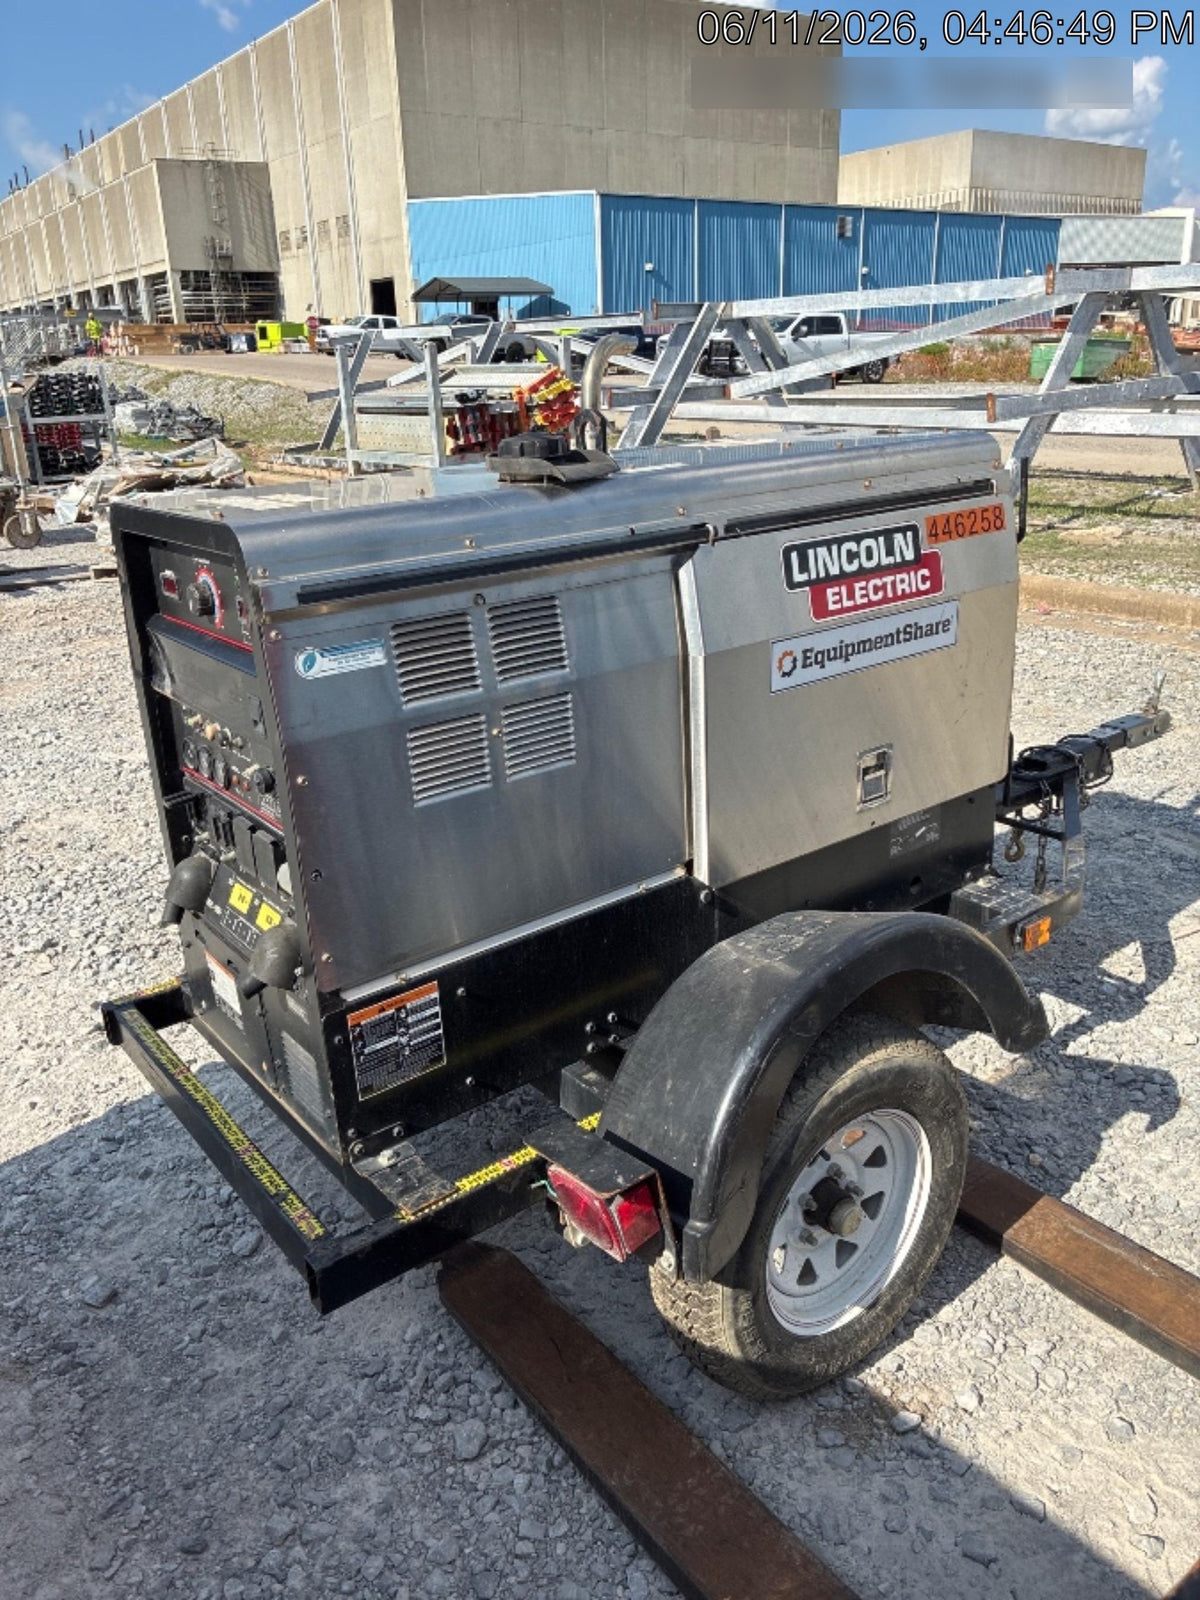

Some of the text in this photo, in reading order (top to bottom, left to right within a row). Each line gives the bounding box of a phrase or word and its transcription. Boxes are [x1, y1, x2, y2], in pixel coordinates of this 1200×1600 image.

[927, 505, 1005, 541] 446258
[789, 530, 916, 583] LINCOLN
[826, 568, 931, 611] ELECTRIC
[801, 617, 951, 670] EquipmentShare
